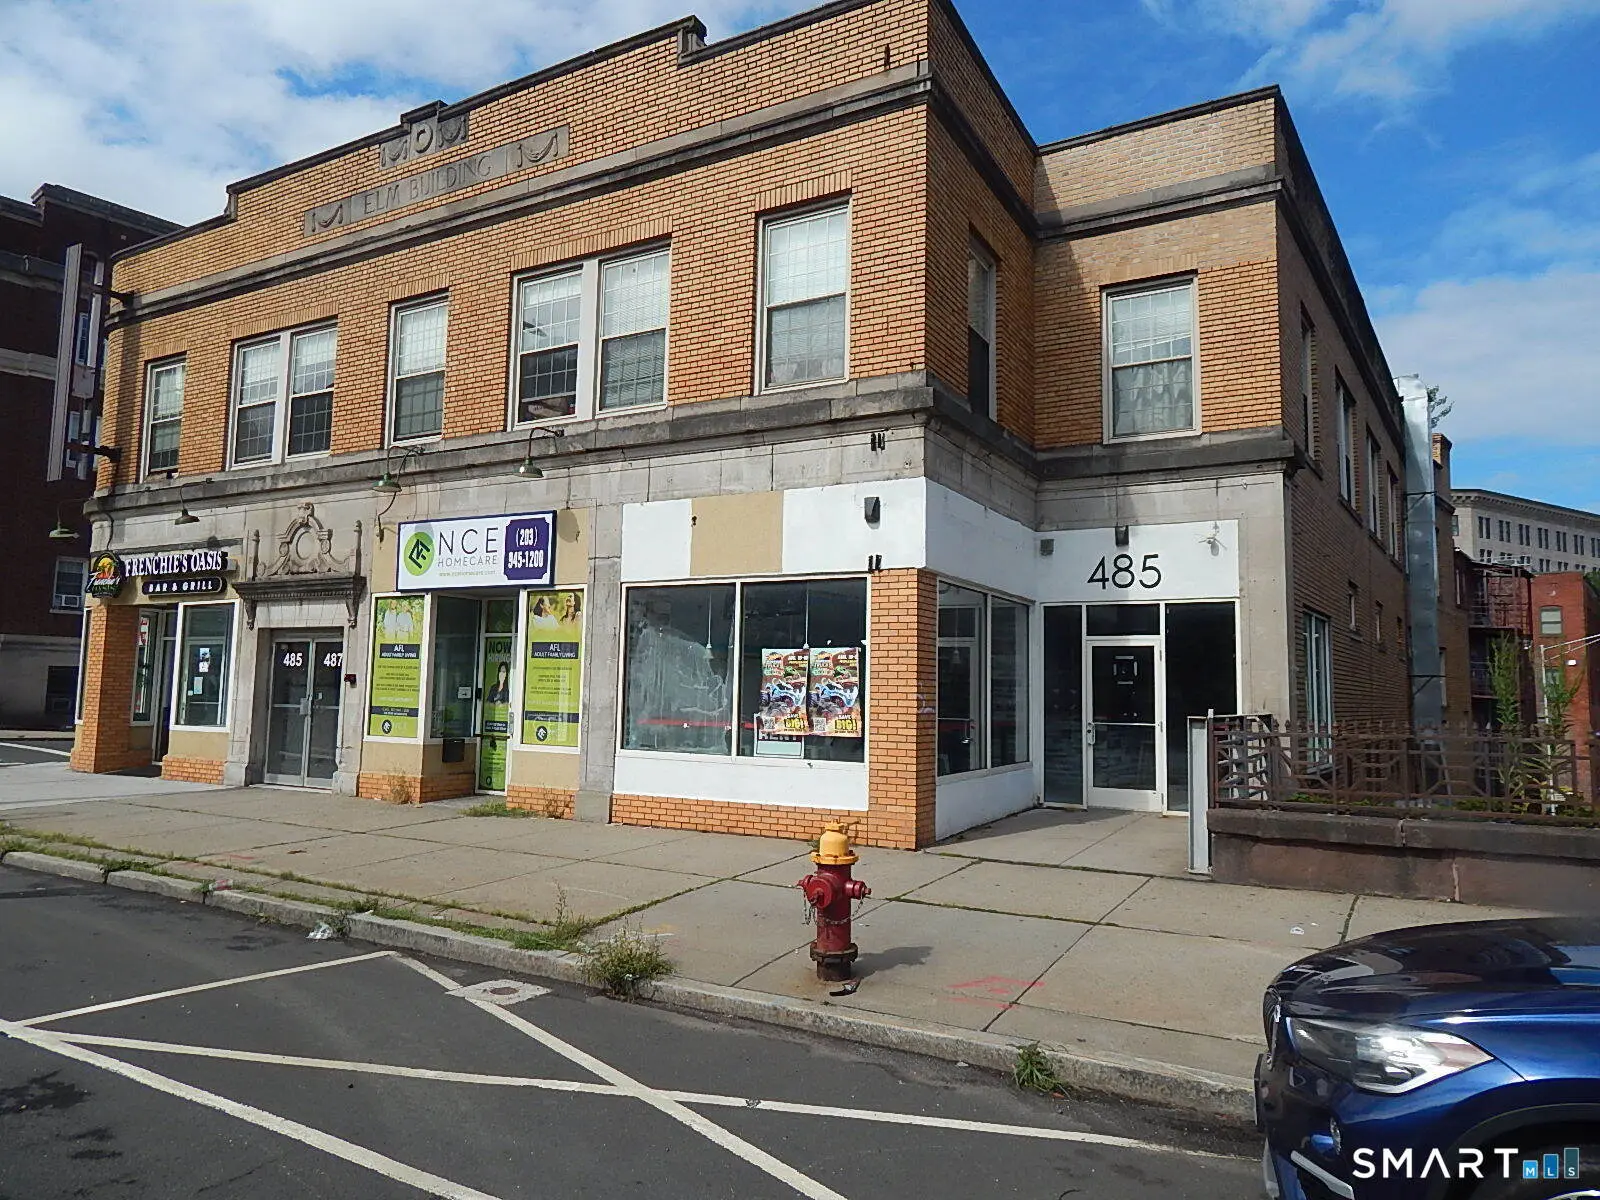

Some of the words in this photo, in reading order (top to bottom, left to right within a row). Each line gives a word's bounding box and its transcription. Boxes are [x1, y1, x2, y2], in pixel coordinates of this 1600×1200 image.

[363, 185, 400, 215] ELM
[410, 155, 492, 200] BUILDING
[438, 527, 499, 556] NCE
[515, 526, 538, 547] (203)
[124, 553, 189, 577] FRENCHIE'S
[190, 550, 223, 571] OASIS
[437, 554, 498, 568] HOMECARE
[507, 550, 544, 569] 945-1200
[1087, 554, 1162, 590] 485
[148, 582, 168, 593] BAR
[171, 582, 178, 592] &
[182, 580, 213, 591] GRILL
[488, 641, 512, 654] NOW
[549, 643, 561, 652] AFL
[283, 652, 303, 667] 485
[323, 652, 343, 667] 487
